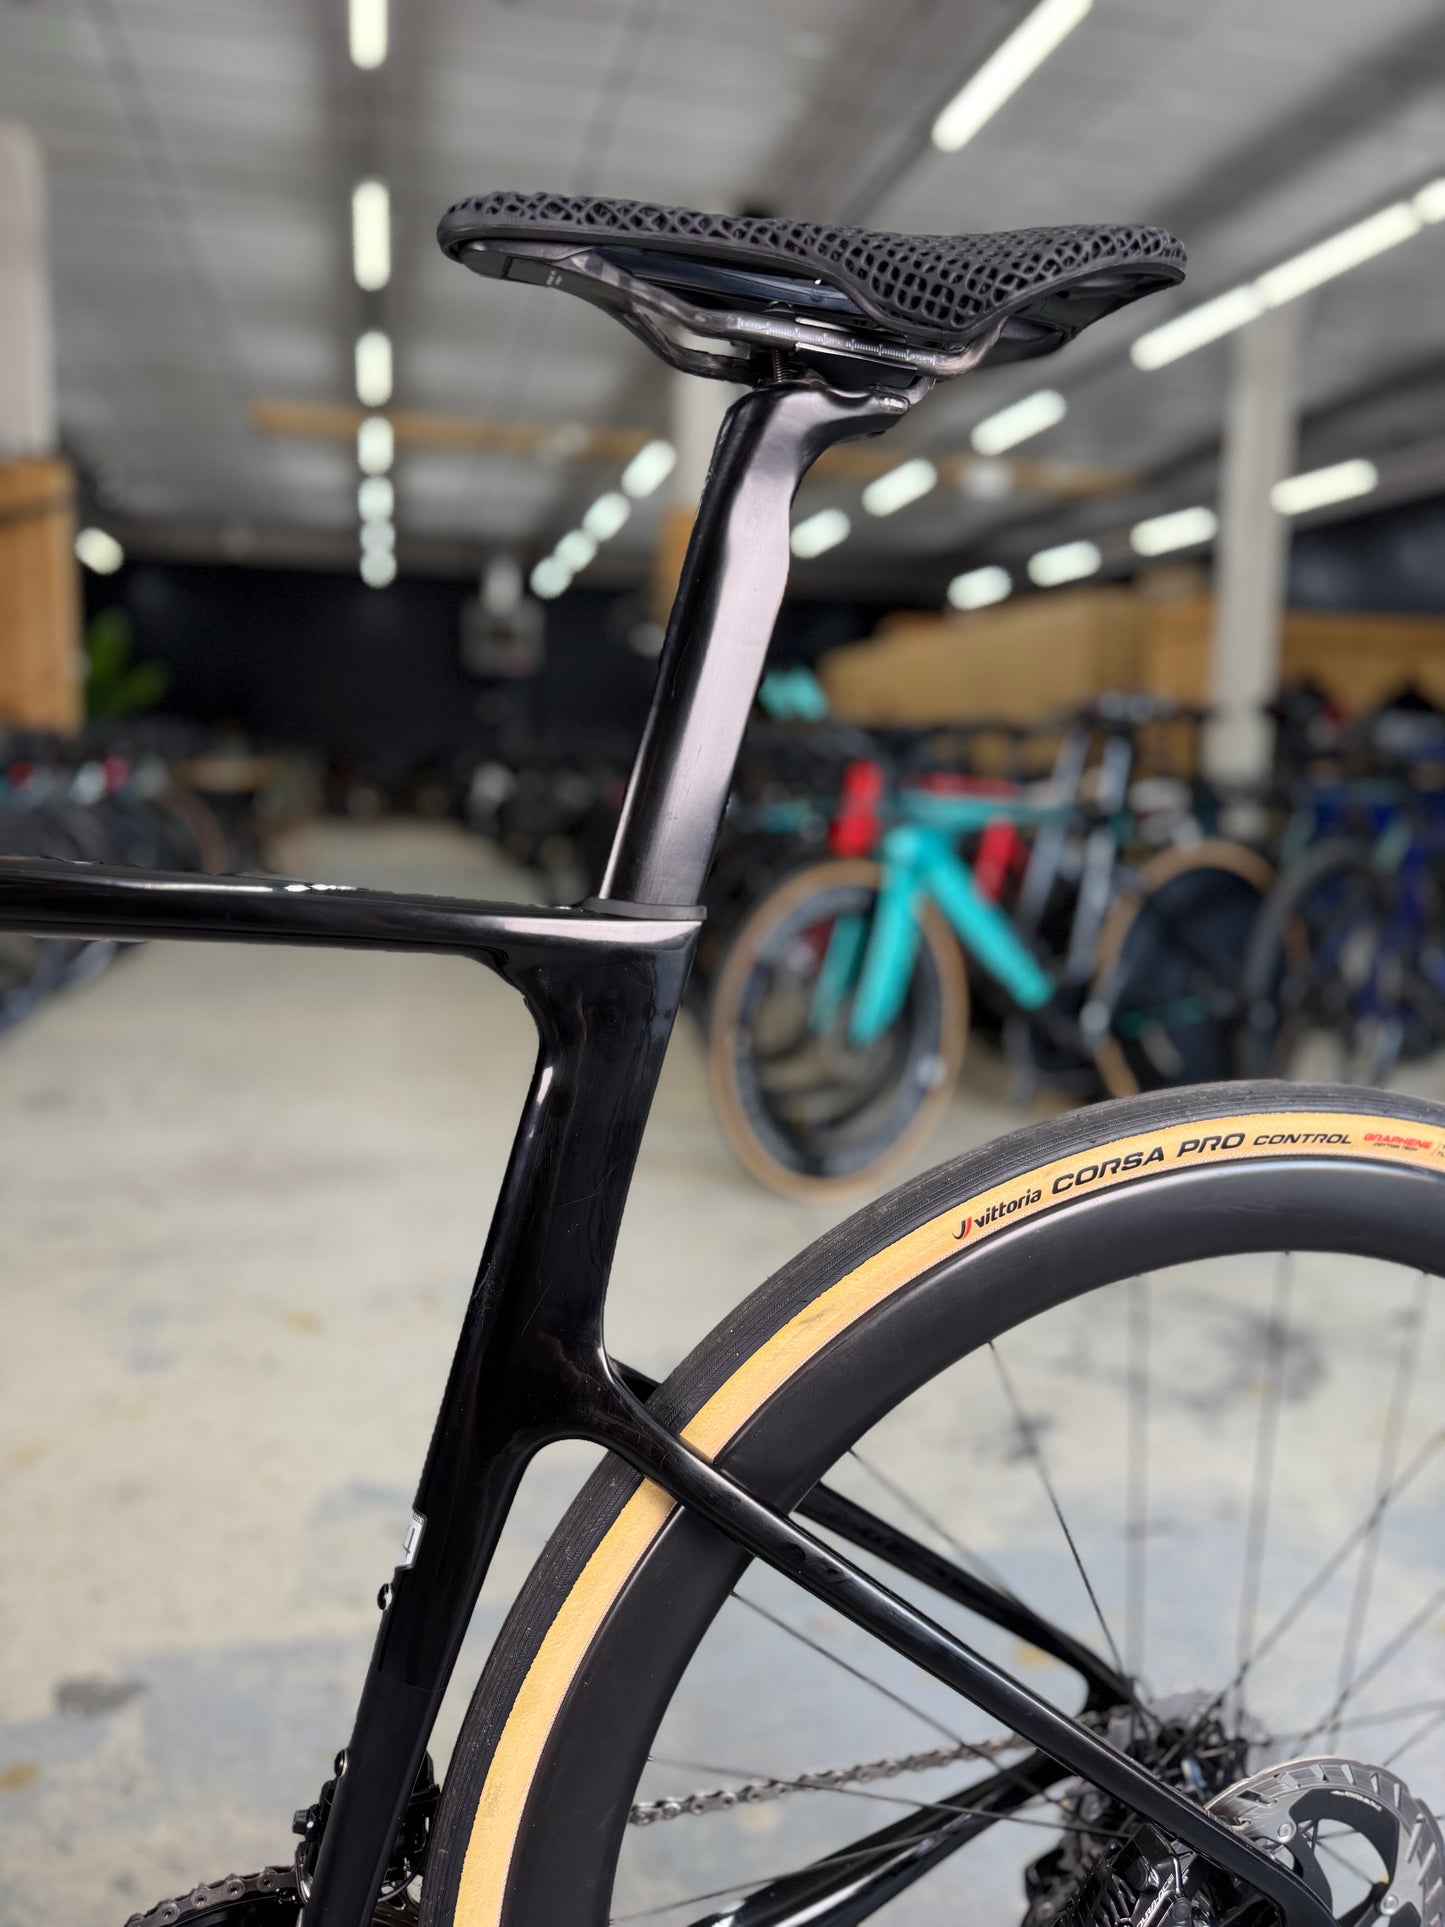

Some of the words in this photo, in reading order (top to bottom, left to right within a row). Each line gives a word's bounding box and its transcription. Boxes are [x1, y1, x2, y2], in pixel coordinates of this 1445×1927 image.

[1364, 1133, 1432, 1149] GRAPHENE
[974, 1188, 1042, 1228] vittoria
[1052, 1146, 1165, 1195] CORSA
[1177, 1132, 1246, 1158] PRO
[1252, 1133, 1352, 1146] CONTROL
